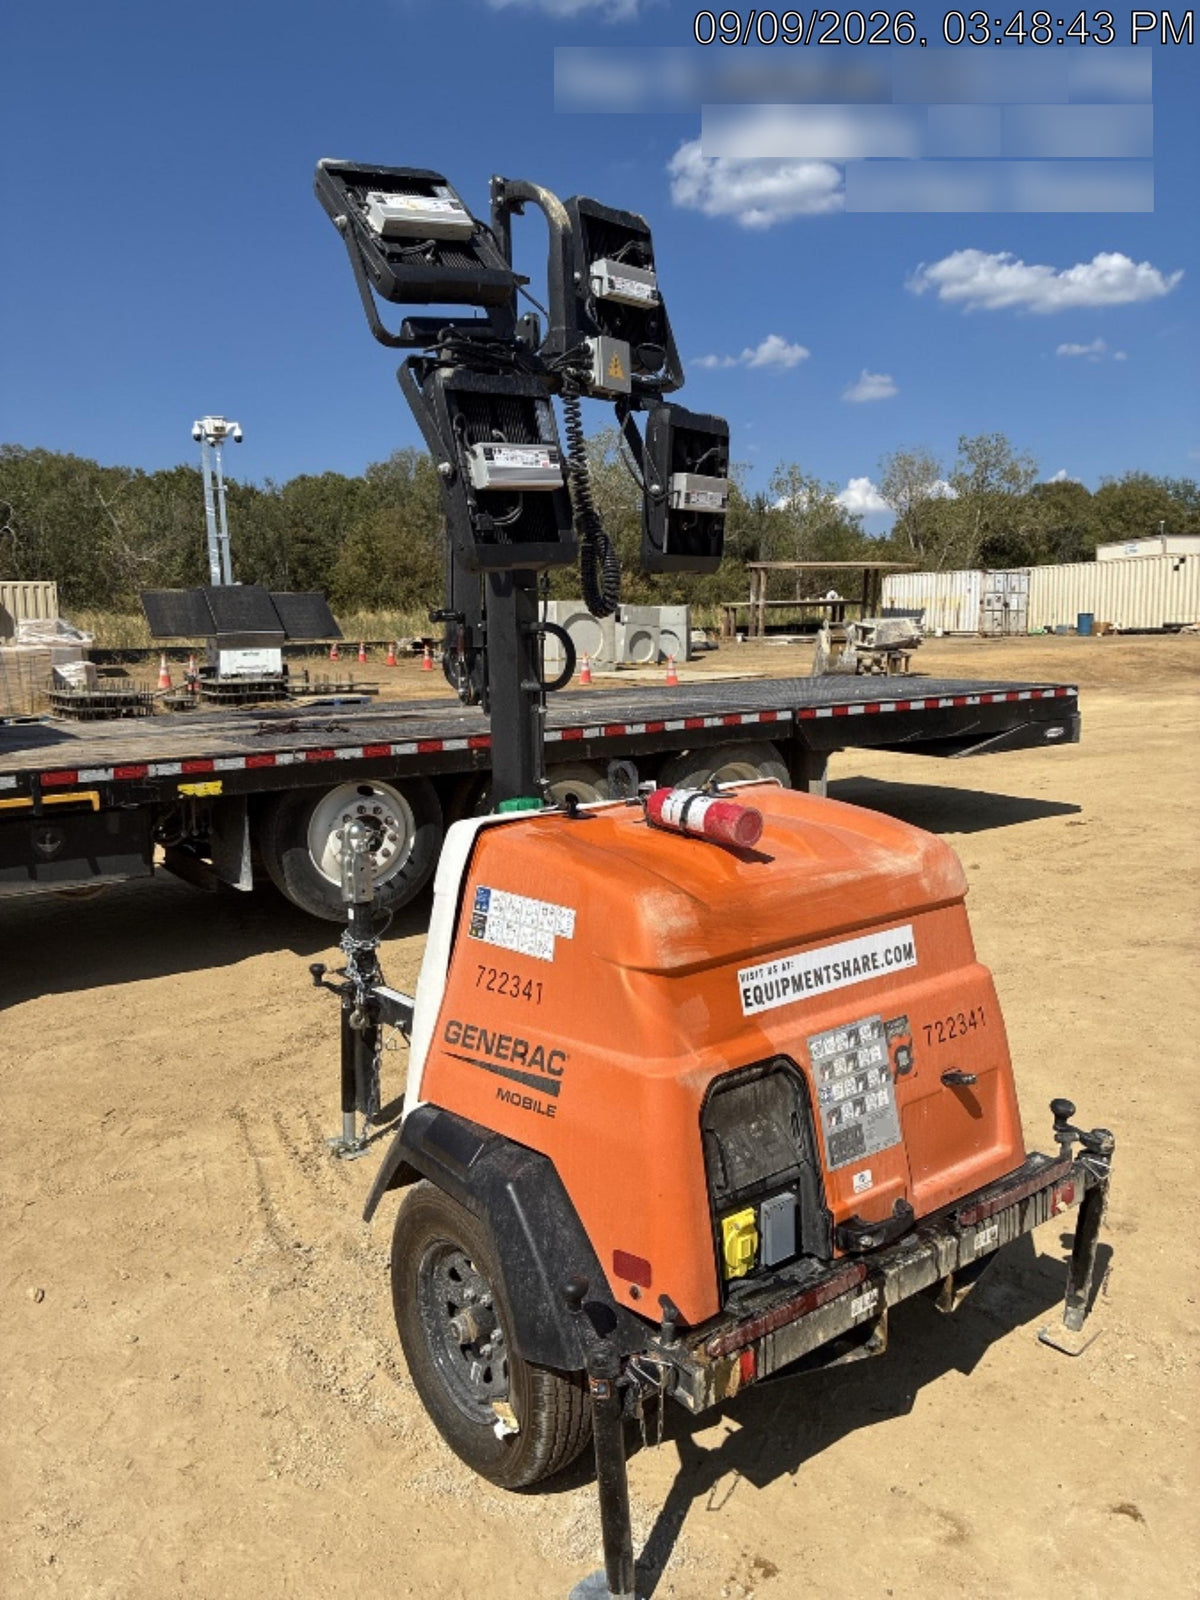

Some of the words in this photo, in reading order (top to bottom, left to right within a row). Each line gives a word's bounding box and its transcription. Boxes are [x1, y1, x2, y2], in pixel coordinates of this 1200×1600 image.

[475, 965, 543, 1005] 722341
[740, 967, 764, 983] VISIT
[767, 964, 778, 976] US
[743, 942, 915, 1008] EQUIPMENTSHARE.COM
[922, 1006, 986, 1047] 722341
[444, 1020, 566, 1076] GENERAC
[496, 1087, 557, 1119] MOBILE
